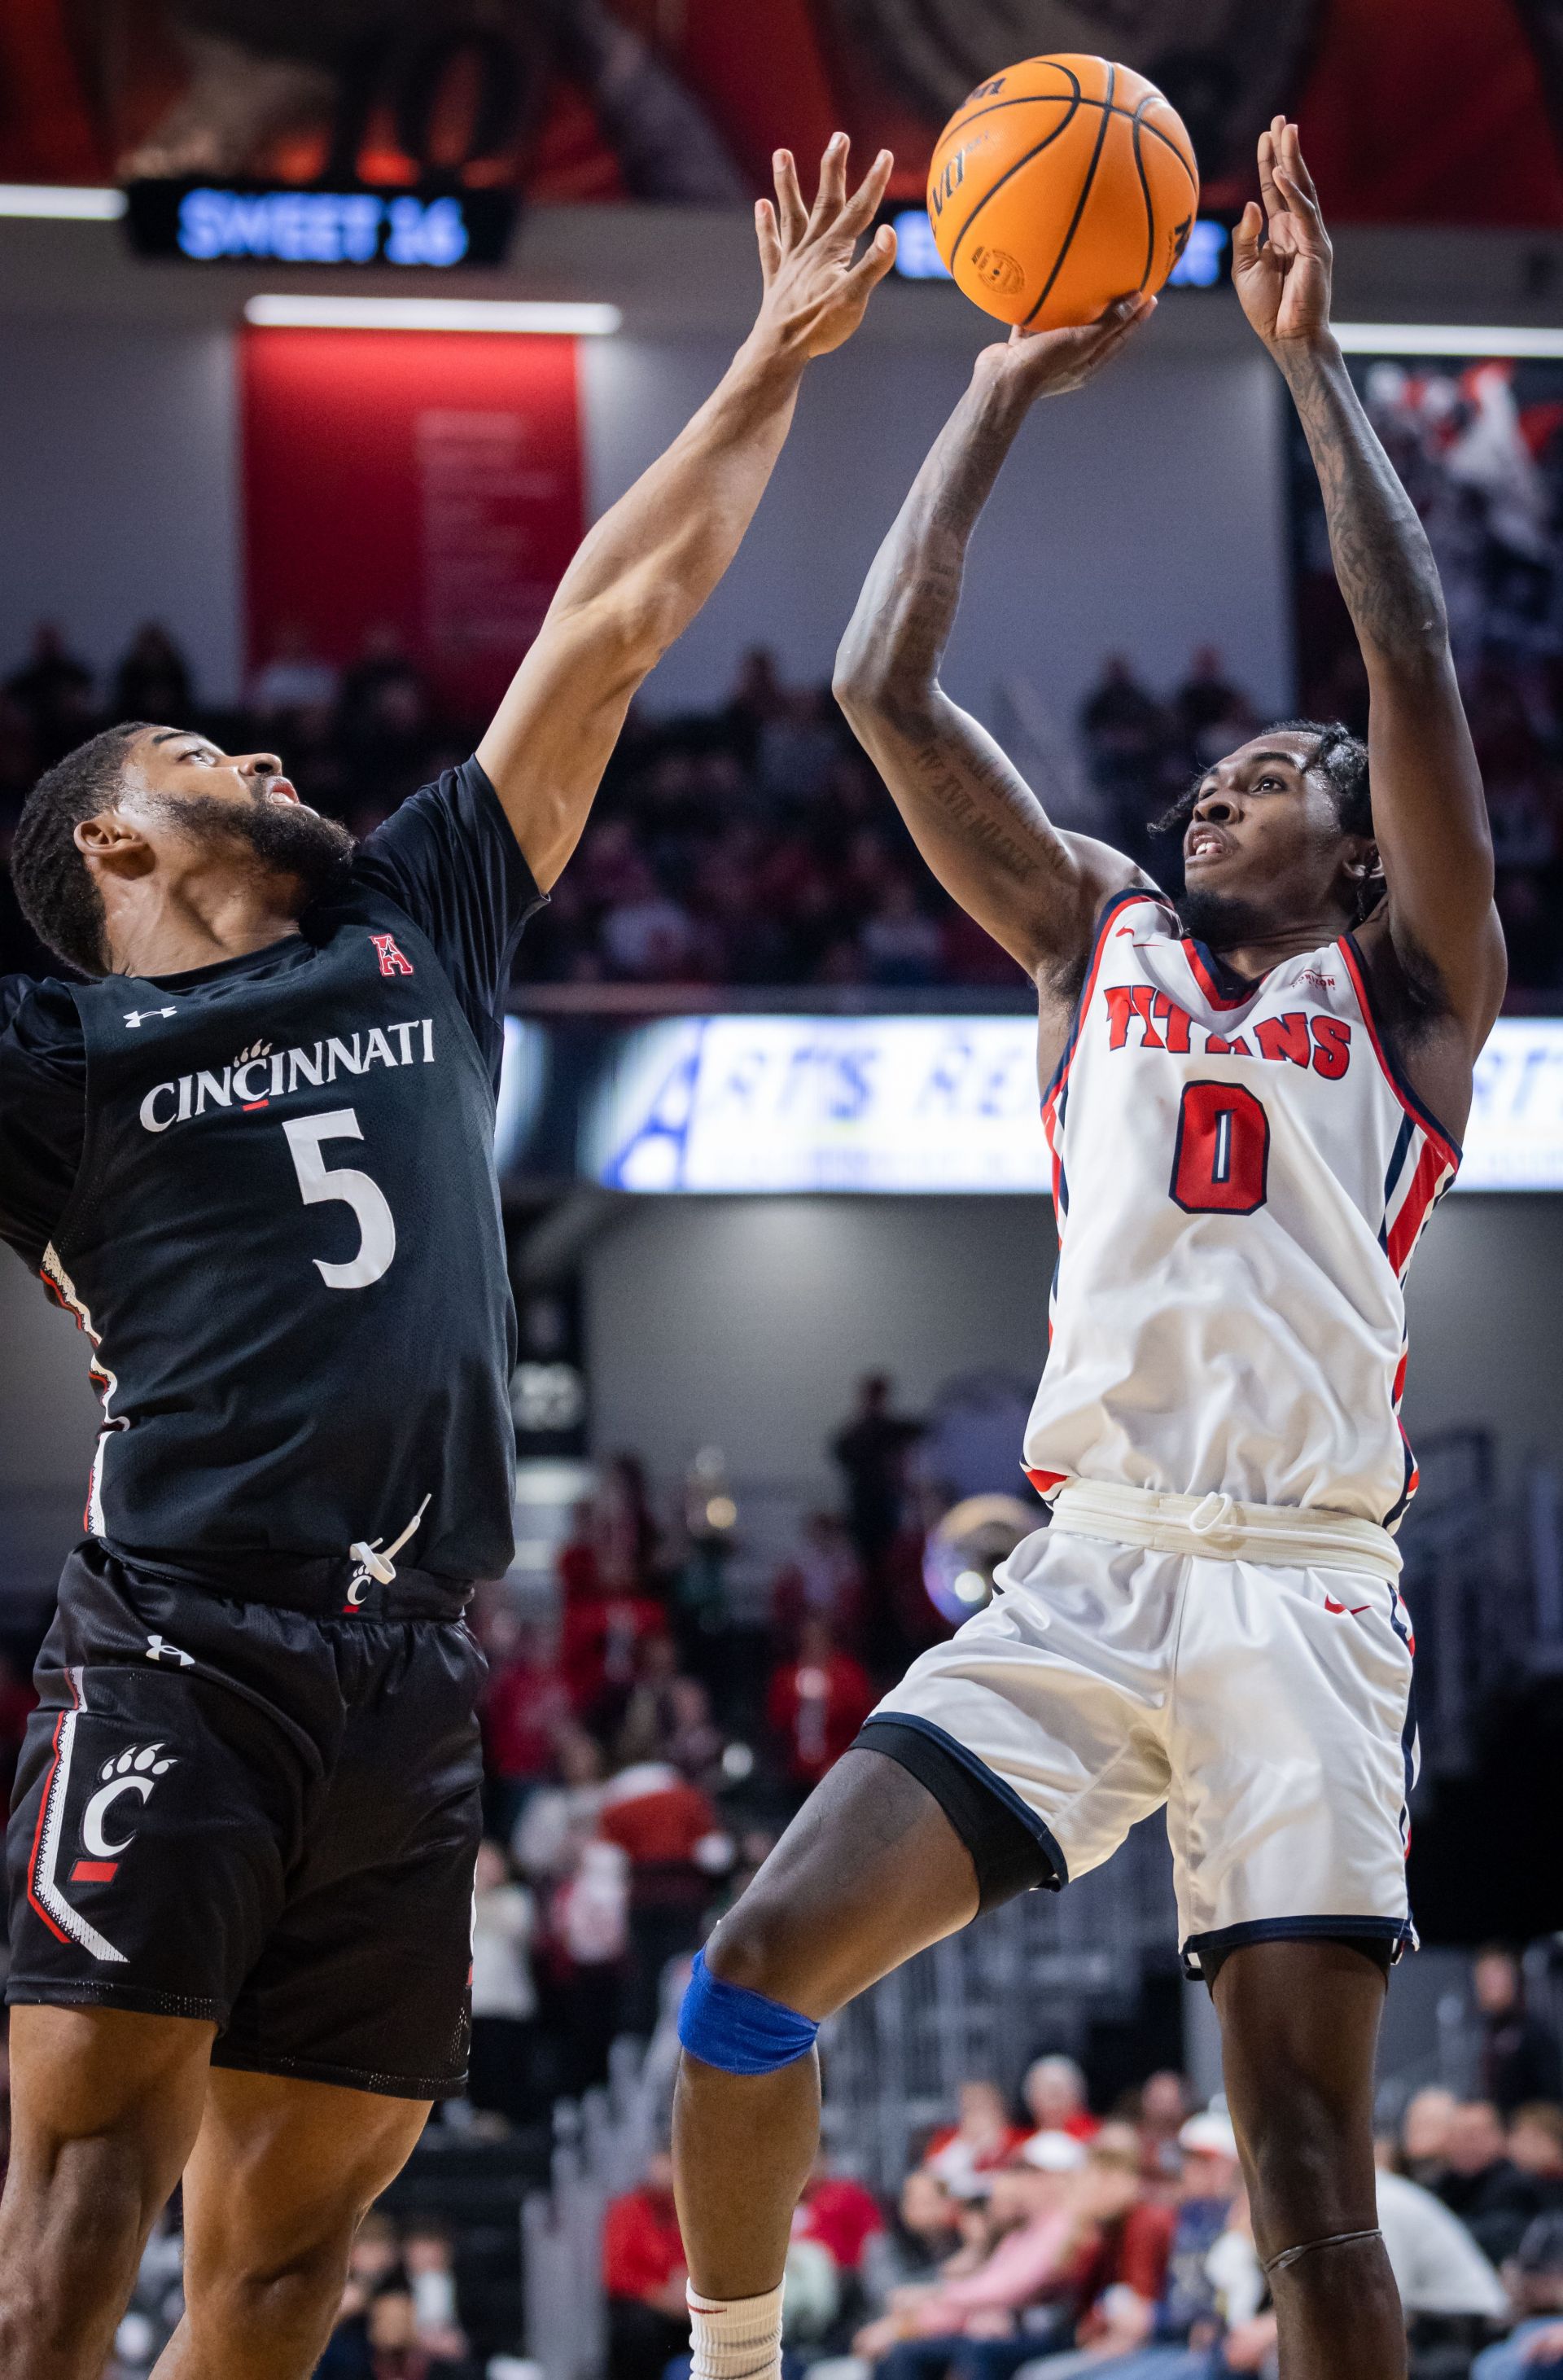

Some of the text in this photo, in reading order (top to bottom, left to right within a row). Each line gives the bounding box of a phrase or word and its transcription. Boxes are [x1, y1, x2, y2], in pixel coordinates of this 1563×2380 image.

[177, 188, 469, 267] SWEET 16
[140, 1019, 435, 1133] CINCINNATI
[1104, 985, 1351, 1080] TITANS
[282, 1108, 396, 1289] 5
[1168, 1080, 1270, 1216] 0
